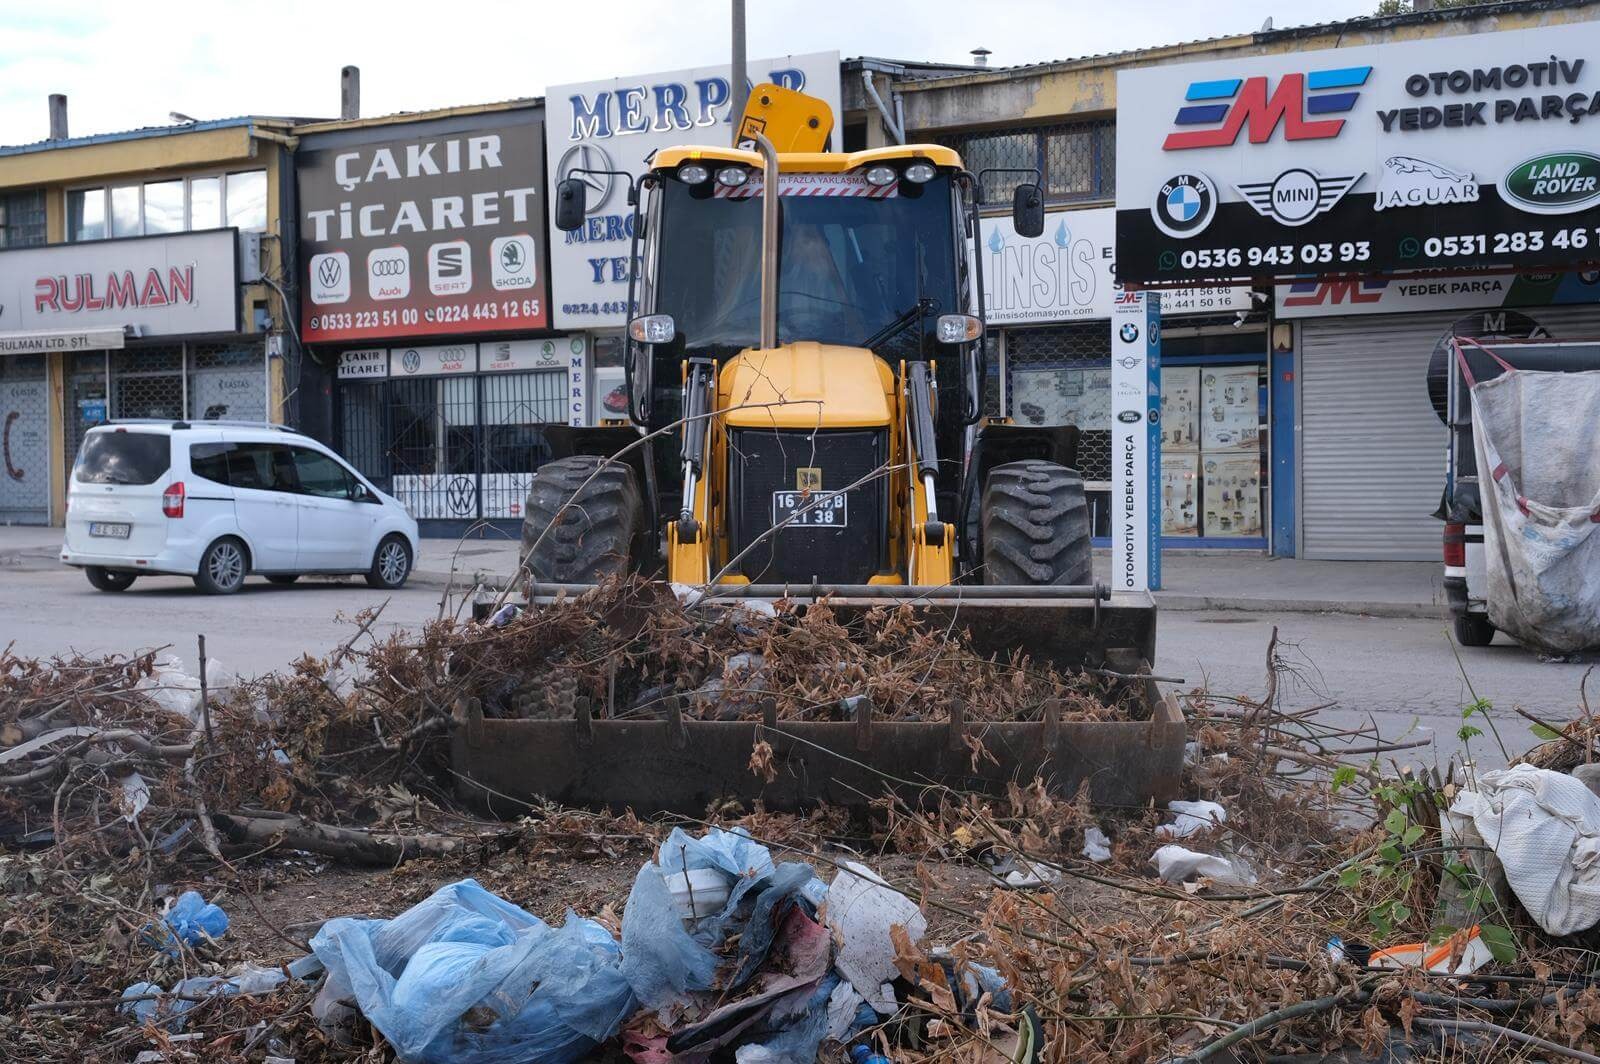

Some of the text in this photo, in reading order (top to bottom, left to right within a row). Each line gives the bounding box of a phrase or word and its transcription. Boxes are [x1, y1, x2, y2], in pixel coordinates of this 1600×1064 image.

[1405, 54, 1585, 97] OTOMOTİV
[568, 69, 806, 141] MERP
[1376, 101, 1487, 132] YEDEK
[335, 135, 503, 191] ÇAKIR
[1528, 162, 1580, 180] LAND
[788, 176, 816, 184] FAZLA
[1162, 175, 1207, 197] BMW
[1532, 177, 1597, 195] ROVER
[1277, 188, 1314, 203] MINI
[1379, 184, 1475, 205] JAGUAR
[307, 188, 536, 241] TİCARET
[1423, 235, 1486, 257] 0531
[1493, 231, 1544, 254] 283
[1551, 228, 1588, 249] 46
[1181, 241, 1371, 269] 0536 943 03 93
[35, 266, 194, 313] RULMAN
[378, 287, 401, 297] Audi
[1175, 288, 1195, 298] 441
[1399, 280, 1503, 297] YEDEK PARÇA
[1175, 300, 1195, 309] 441
[1200, 298, 1213, 307] 50
[1218, 297, 1231, 306] 16
[321, 300, 540, 330] 0533 223 51 00 0224 443 12 65
[46, 338, 68, 348] LTD.
[71, 335, 90, 349] ŞTİ.
[340, 364, 385, 375] TİCARET
[442, 361, 462, 371] Audi
[778, 494, 795, 508] 16
[814, 510, 834, 523] 38
[1126, 435, 1136, 587] OTOMOTİV YEDEK PARÇA
